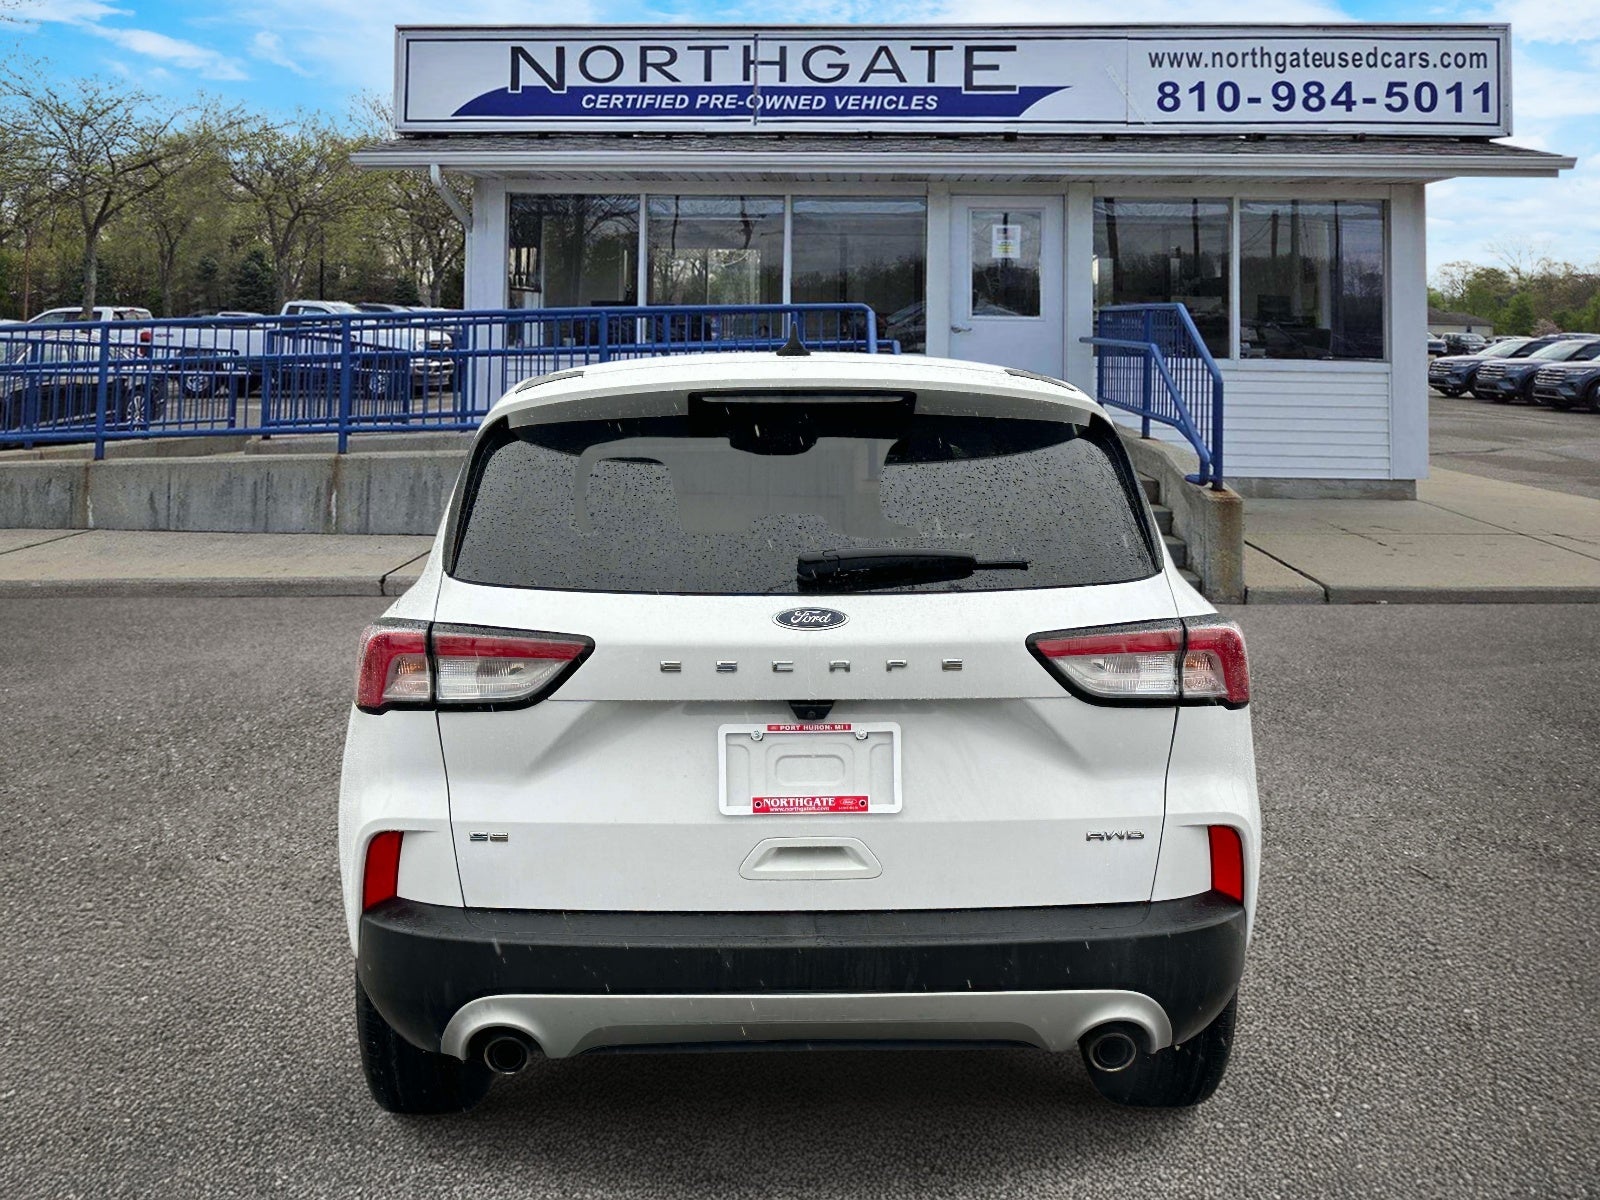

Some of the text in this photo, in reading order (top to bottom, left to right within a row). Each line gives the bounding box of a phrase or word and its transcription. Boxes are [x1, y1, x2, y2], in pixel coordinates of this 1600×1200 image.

[1149, 47, 1488, 73] www.northgateusedcars.com
[509, 45, 1017, 94] NORTHGATE
[581, 94, 938, 111] CERTIFIED PRE-OWNED VEHICLES
[1156, 80, 1491, 113] 810-984-5011
[790, 610, 831, 623] Ford
[660, 659, 963, 672] ESCAPE
[763, 797, 836, 806] NORTHGATE
[469, 831, 508, 842] SE
[1086, 831, 1144, 841] AWD
